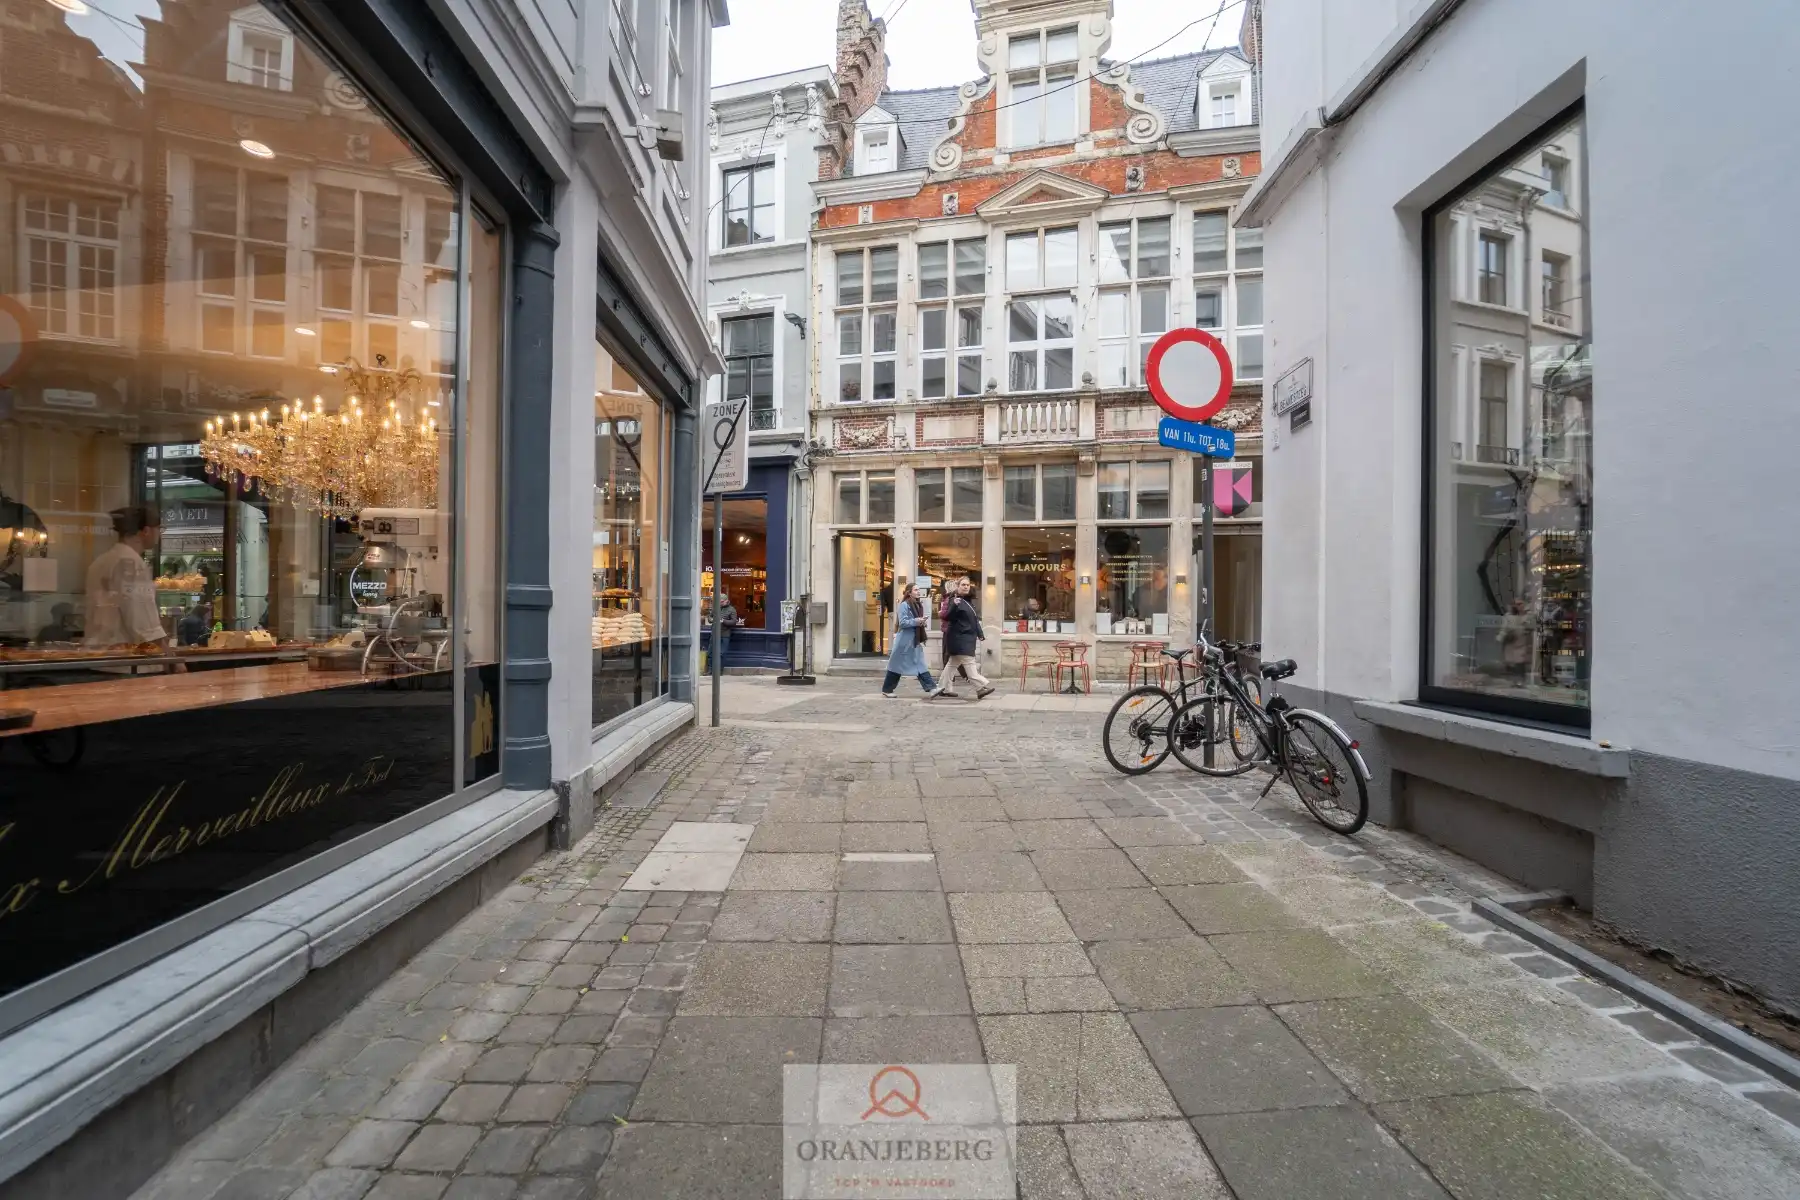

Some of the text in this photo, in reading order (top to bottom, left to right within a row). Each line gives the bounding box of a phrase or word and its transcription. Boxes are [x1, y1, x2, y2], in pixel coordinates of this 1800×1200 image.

[713, 404, 738, 418] ZONE
[1164, 427, 1231, 450] VAN 11u. TOT 18u.
[1012, 563, 1066, 572] FLAVOURS
[352, 582, 388, 590] MEZZO
[58, 762, 330, 893] Merveilleux
[355, 755, 395, 789] Fred
